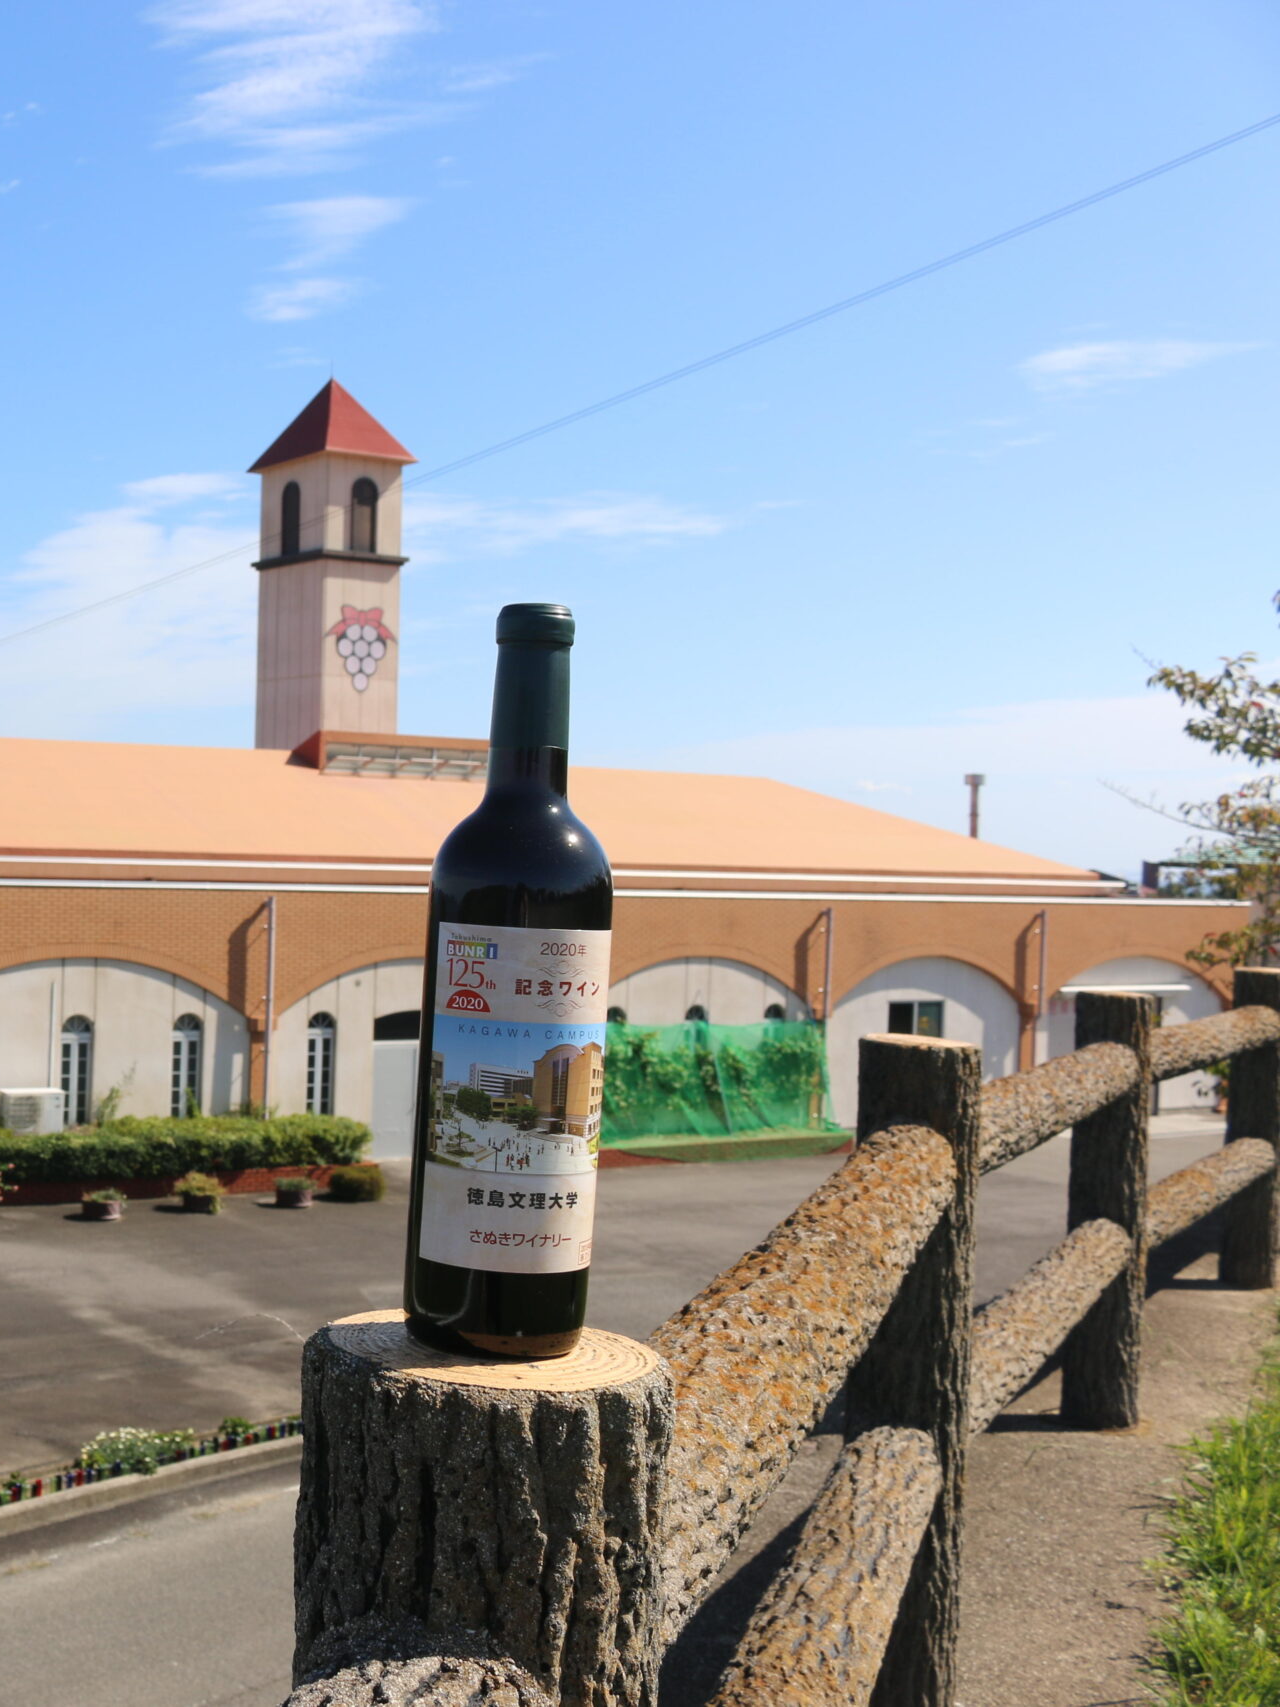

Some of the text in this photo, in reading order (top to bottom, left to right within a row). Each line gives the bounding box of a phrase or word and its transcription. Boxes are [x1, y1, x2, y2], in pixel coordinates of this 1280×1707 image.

[540, 942, 587, 957] 2020年
[514, 978, 600, 997] 記念ワイン
[451, 995, 484, 1010] 2020
[458, 1023, 600, 1041] KAGAWA CAMPUS
[467, 1187, 578, 1210] 徳島文理大学
[469, 1229, 572, 1248] さぬきワイナリー
